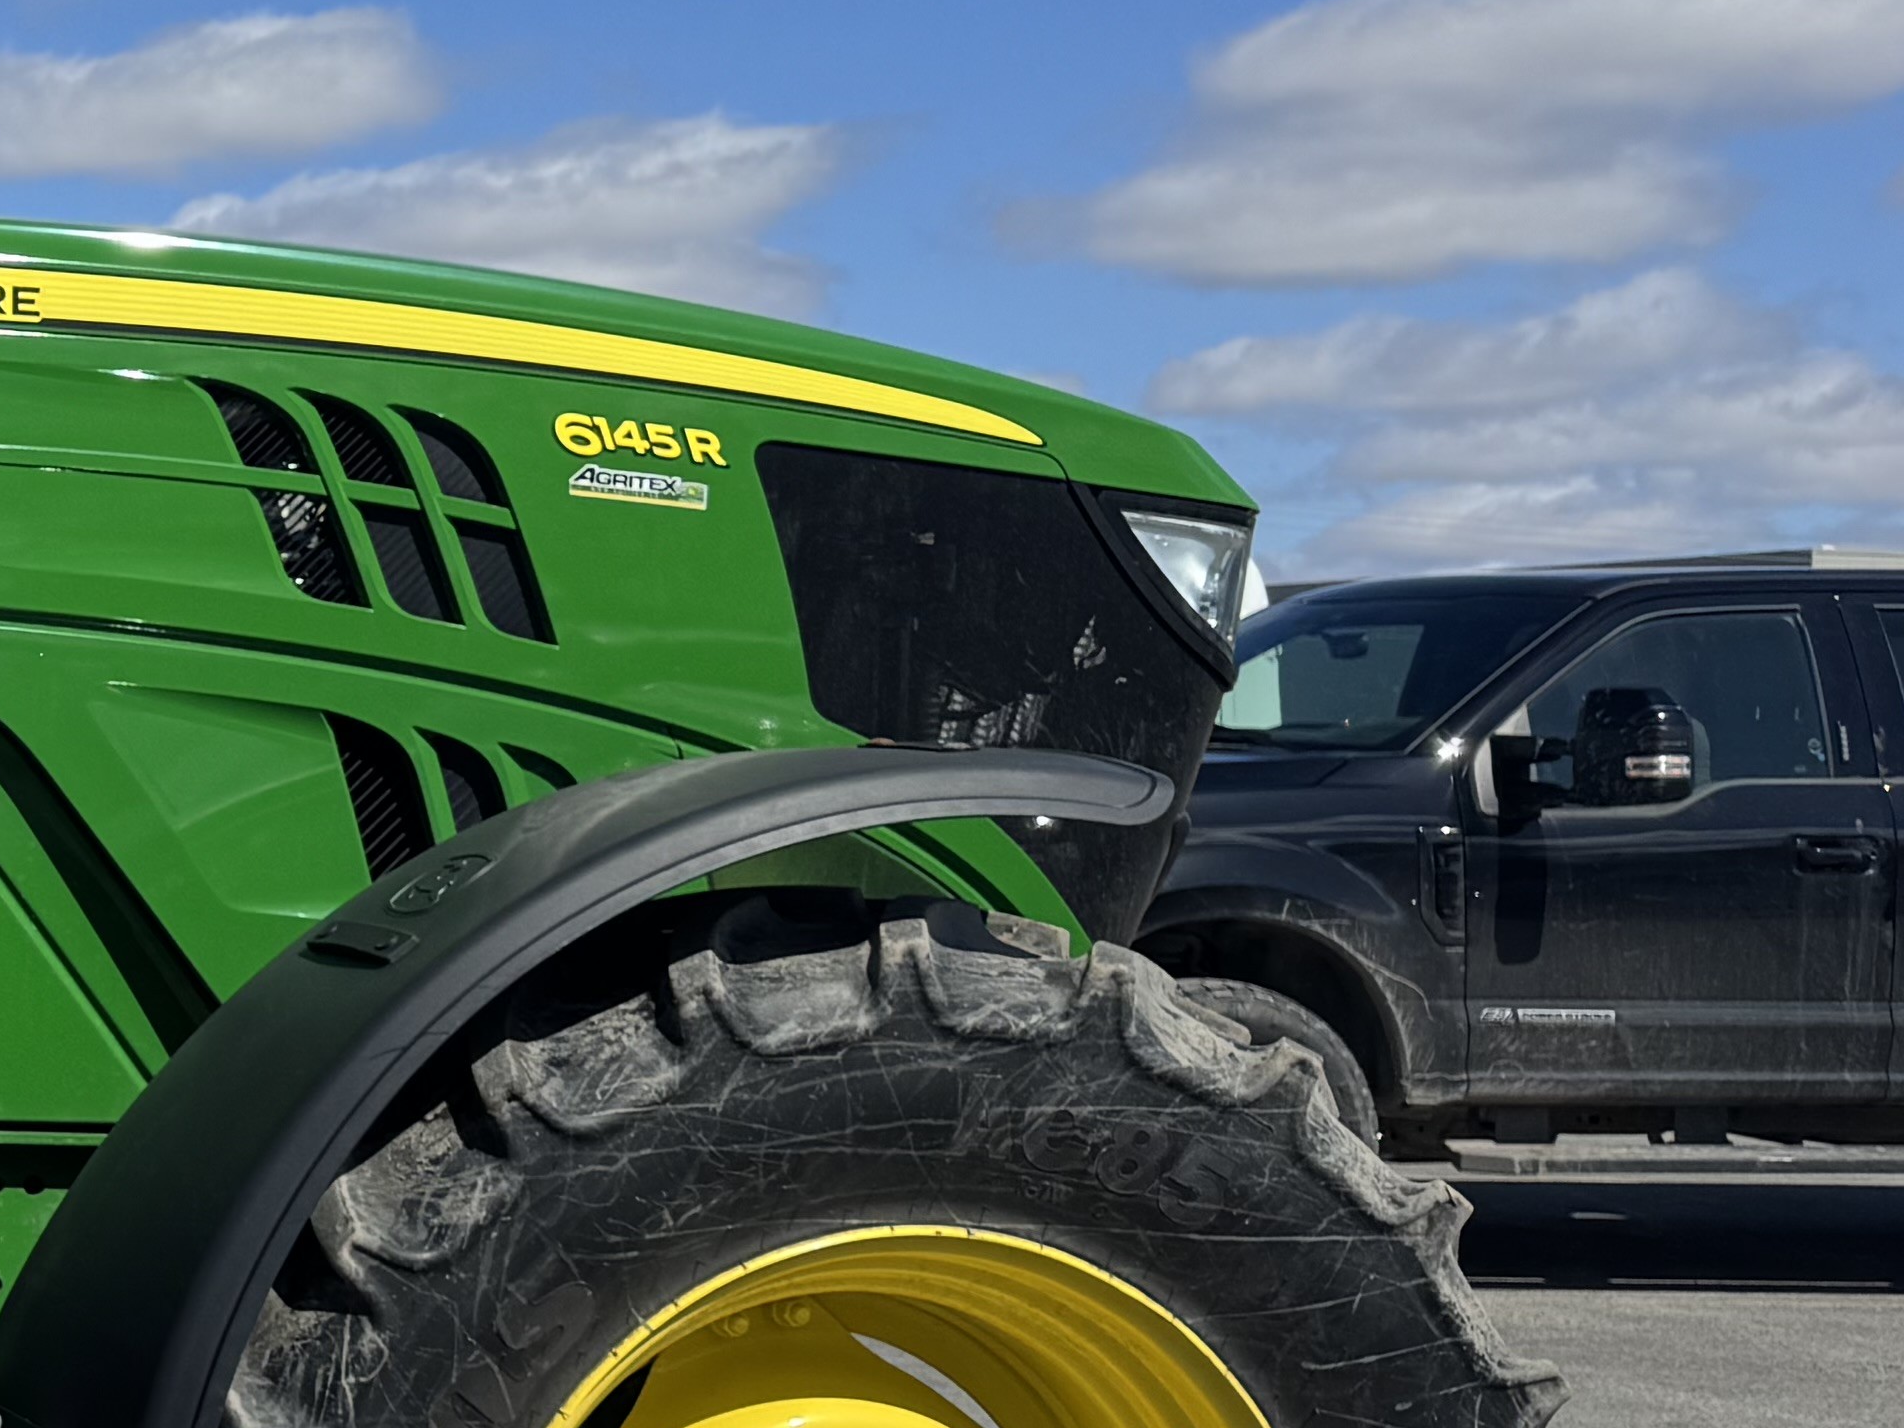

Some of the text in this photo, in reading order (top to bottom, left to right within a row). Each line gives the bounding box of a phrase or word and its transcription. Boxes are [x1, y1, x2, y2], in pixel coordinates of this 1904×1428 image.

[553, 412, 727, 467] 6145 R
[574, 467, 676, 493] AGRITEX
